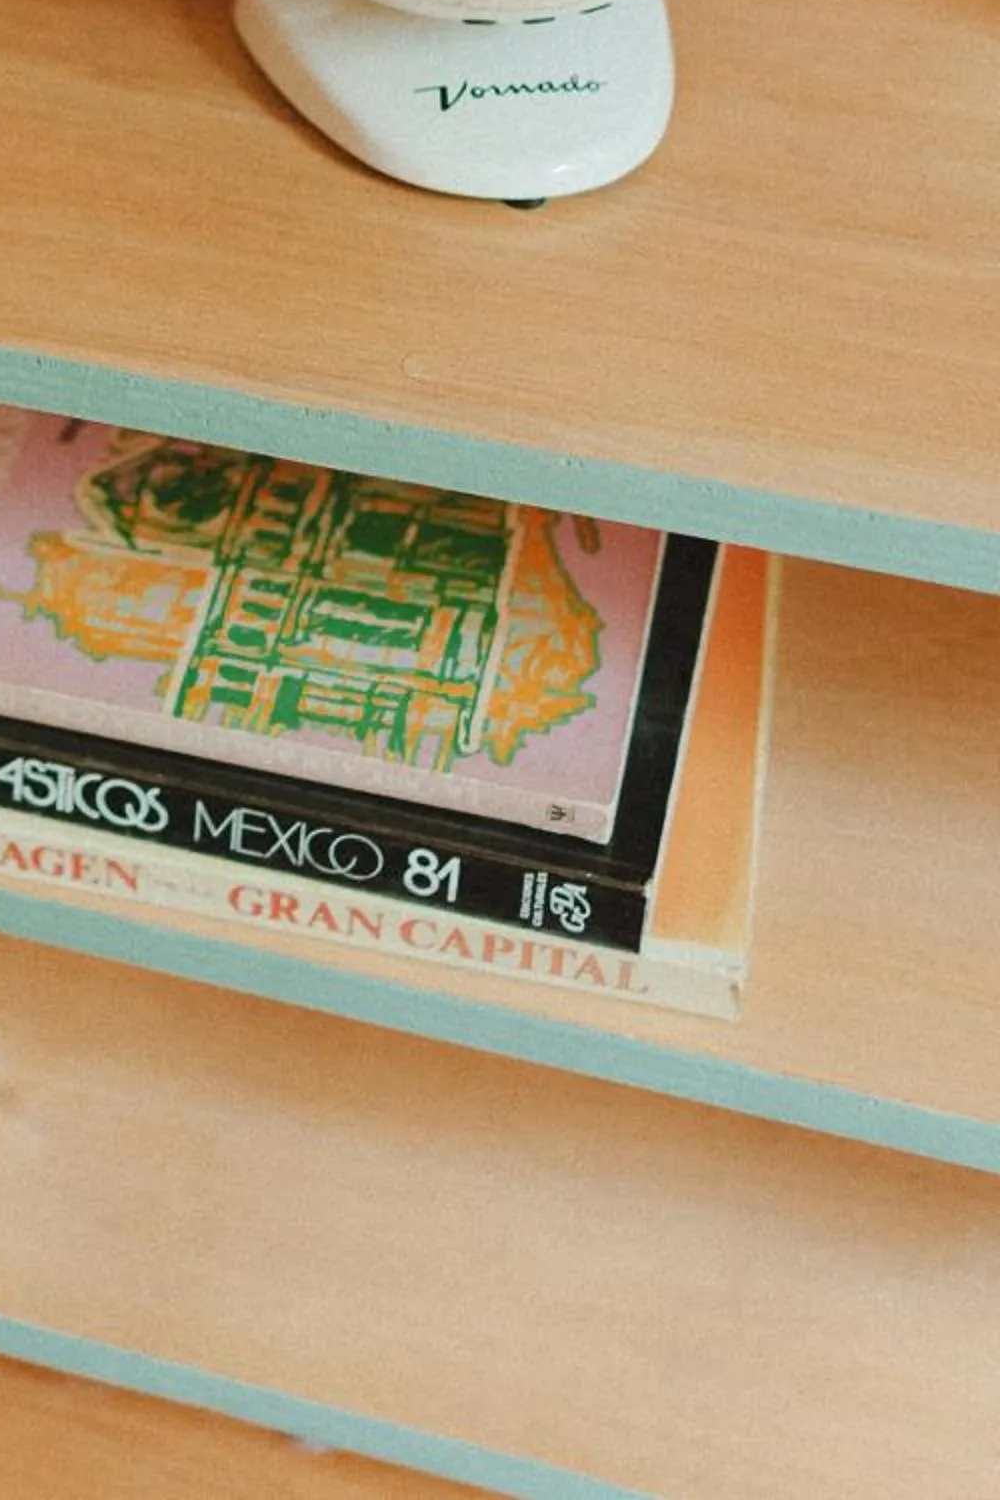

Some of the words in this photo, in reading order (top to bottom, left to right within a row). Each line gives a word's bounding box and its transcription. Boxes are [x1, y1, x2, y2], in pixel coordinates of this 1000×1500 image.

[414, 74, 608, 112] Vornado
[193, 799, 385, 881] MEXICO
[402, 847, 462, 904] 81
[228, 883, 386, 942] GRAN
[400, 915, 652, 995] CAPITAL
